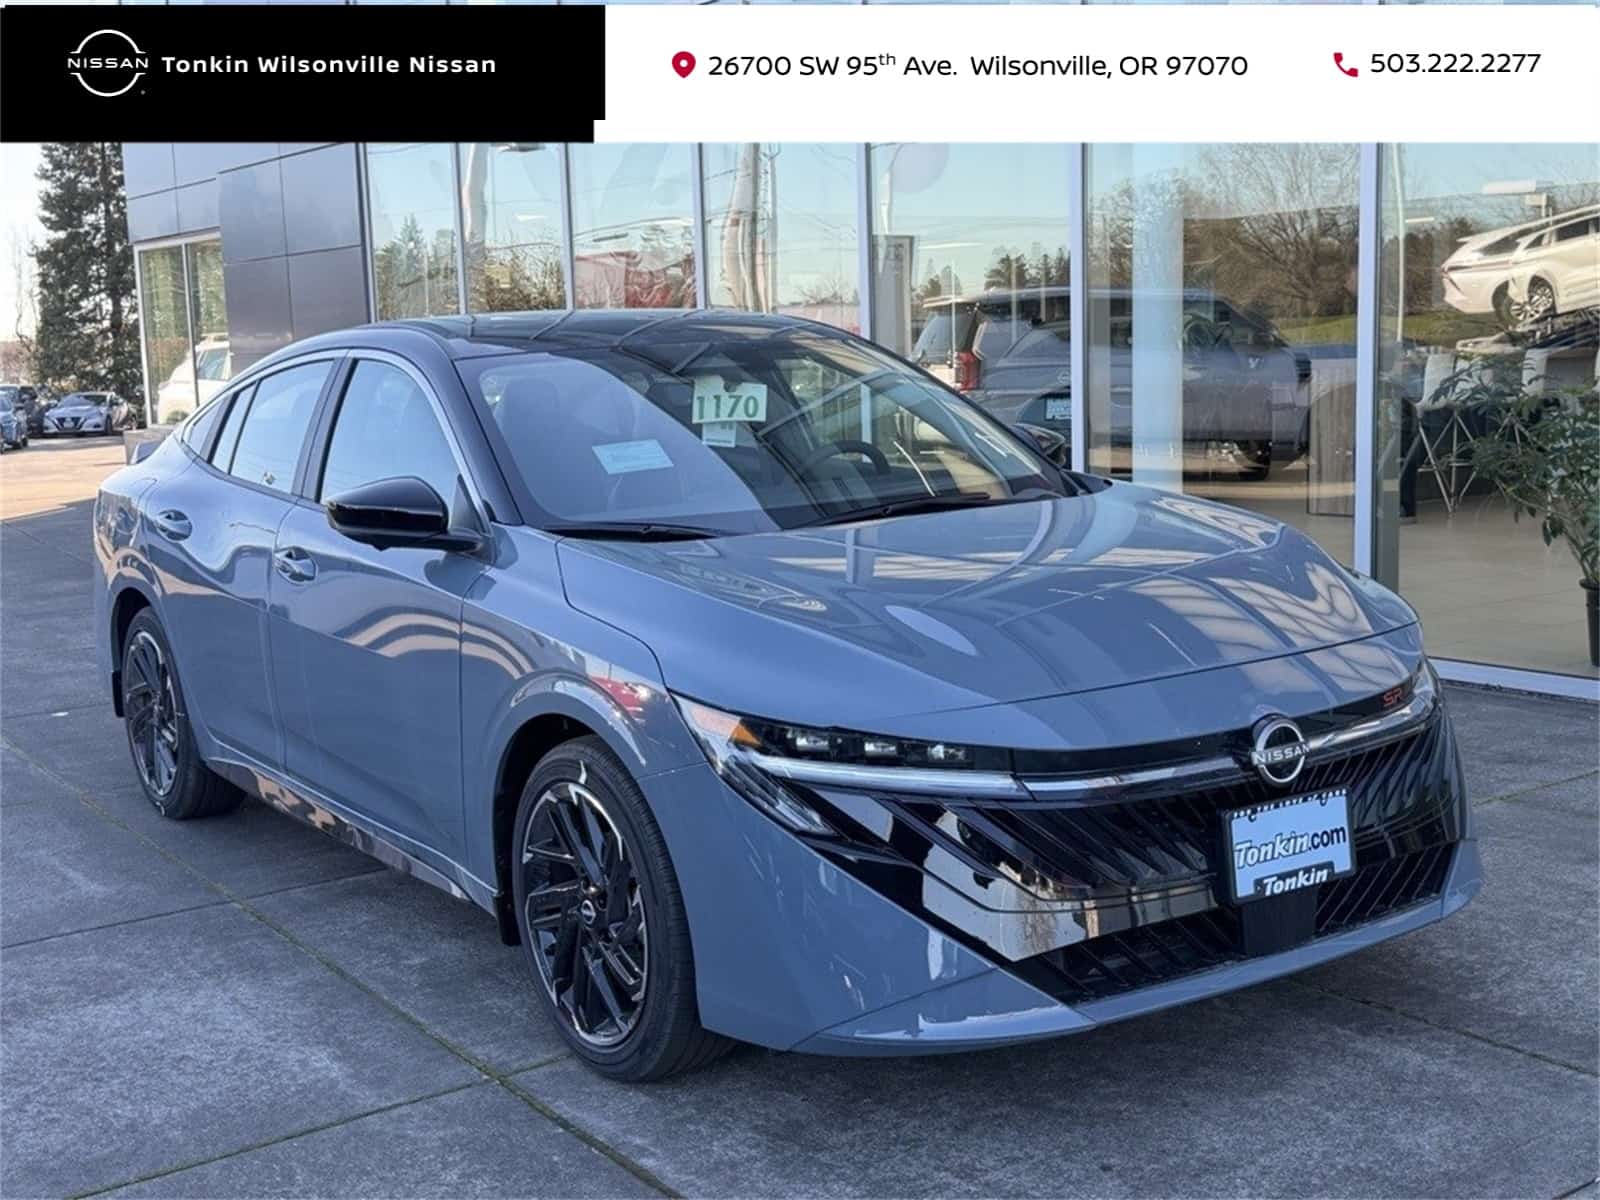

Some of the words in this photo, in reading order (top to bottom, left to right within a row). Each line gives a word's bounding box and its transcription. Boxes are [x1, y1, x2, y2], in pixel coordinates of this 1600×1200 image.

[696, 394, 760, 419] 1170
[1252, 744, 1310, 765] NISSAN
[1234, 826, 1347, 869] Tonkin.com
[1263, 868, 1328, 896] Tonkin
